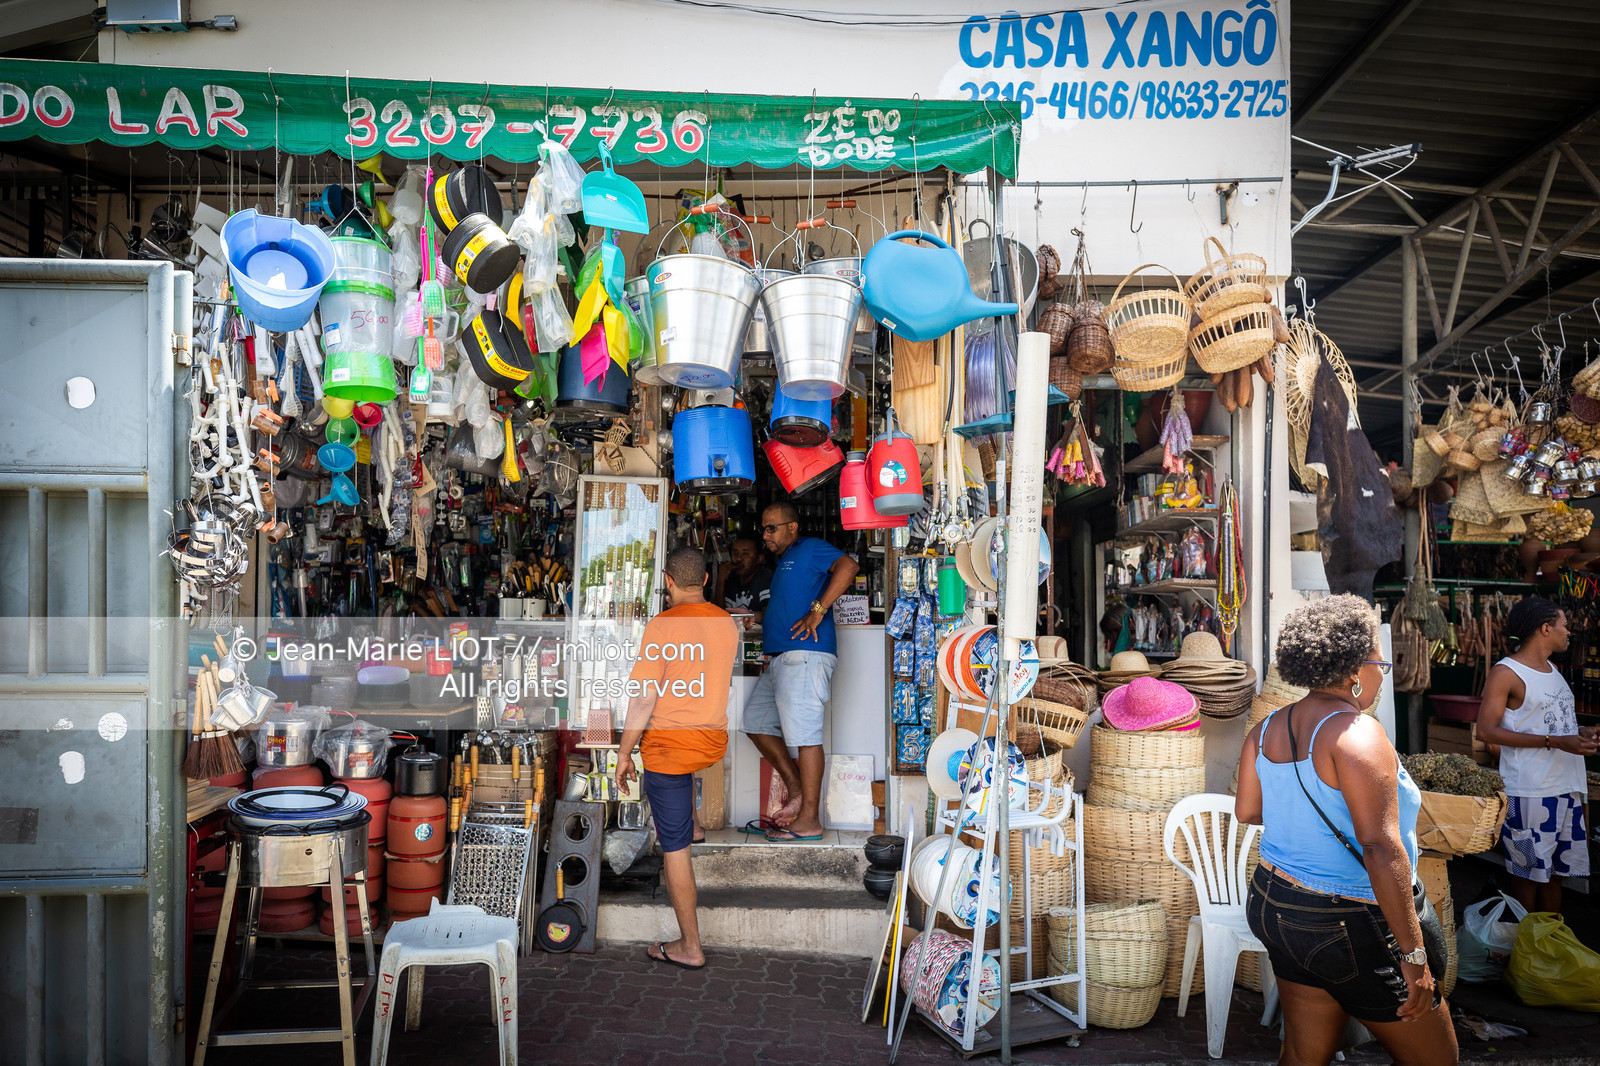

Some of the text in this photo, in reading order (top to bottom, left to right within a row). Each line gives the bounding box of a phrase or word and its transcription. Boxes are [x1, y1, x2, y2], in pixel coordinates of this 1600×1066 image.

[959, 0, 1277, 69] CASA XANGÔ
[0, 82, 75, 128] DO
[106, 84, 249, 138] LAR
[861, 109, 901, 136] DO
[798, 134, 896, 166] BODE
